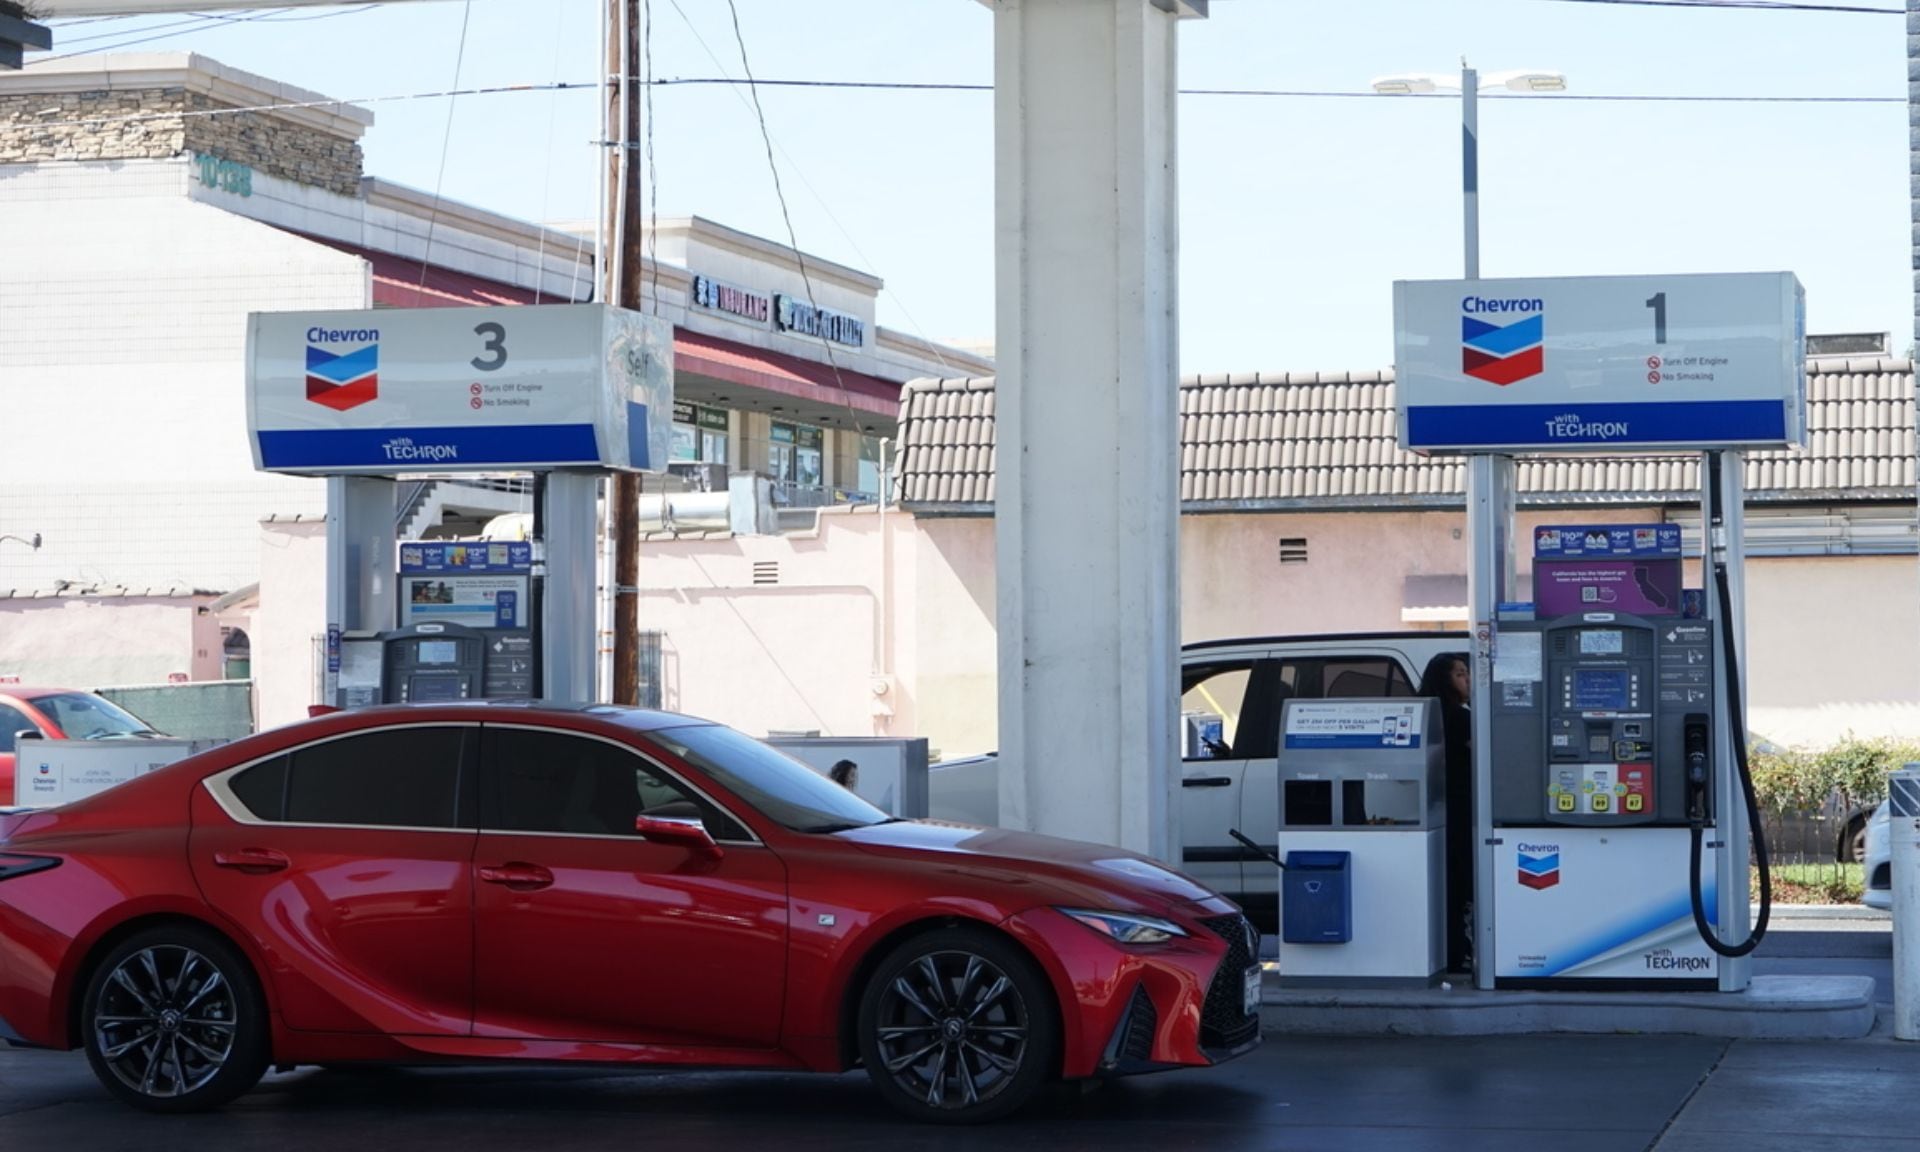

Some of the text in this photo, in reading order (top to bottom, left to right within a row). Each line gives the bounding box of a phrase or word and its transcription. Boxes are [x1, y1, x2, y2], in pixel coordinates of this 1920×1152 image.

[1462, 296, 1544, 313] Chevron
[1646, 292, 1667, 344] 1
[306, 327, 380, 343] Chevron
[470, 321, 508, 372] 3
[628, 350, 650, 379] Self
[1663, 355, 1729, 368] Turn Off Engine
[1662, 371, 1715, 383] No Smoking
[484, 383, 543, 393] Turn Off Engine
[483, 397, 530, 408] No Smoking
[1555, 413, 1580, 423] with
[1545, 421, 1628, 439] TECHRON
[389, 437, 413, 447] with
[382, 444, 457, 461] TECHRON
[1676, 626, 1706, 634] Gasoline
[1366, 772, 1388, 780] Trash
[1517, 842, 1560, 853] Chevron
[1652, 948, 1672, 957] with
[1644, 955, 1710, 972] TECHRON
